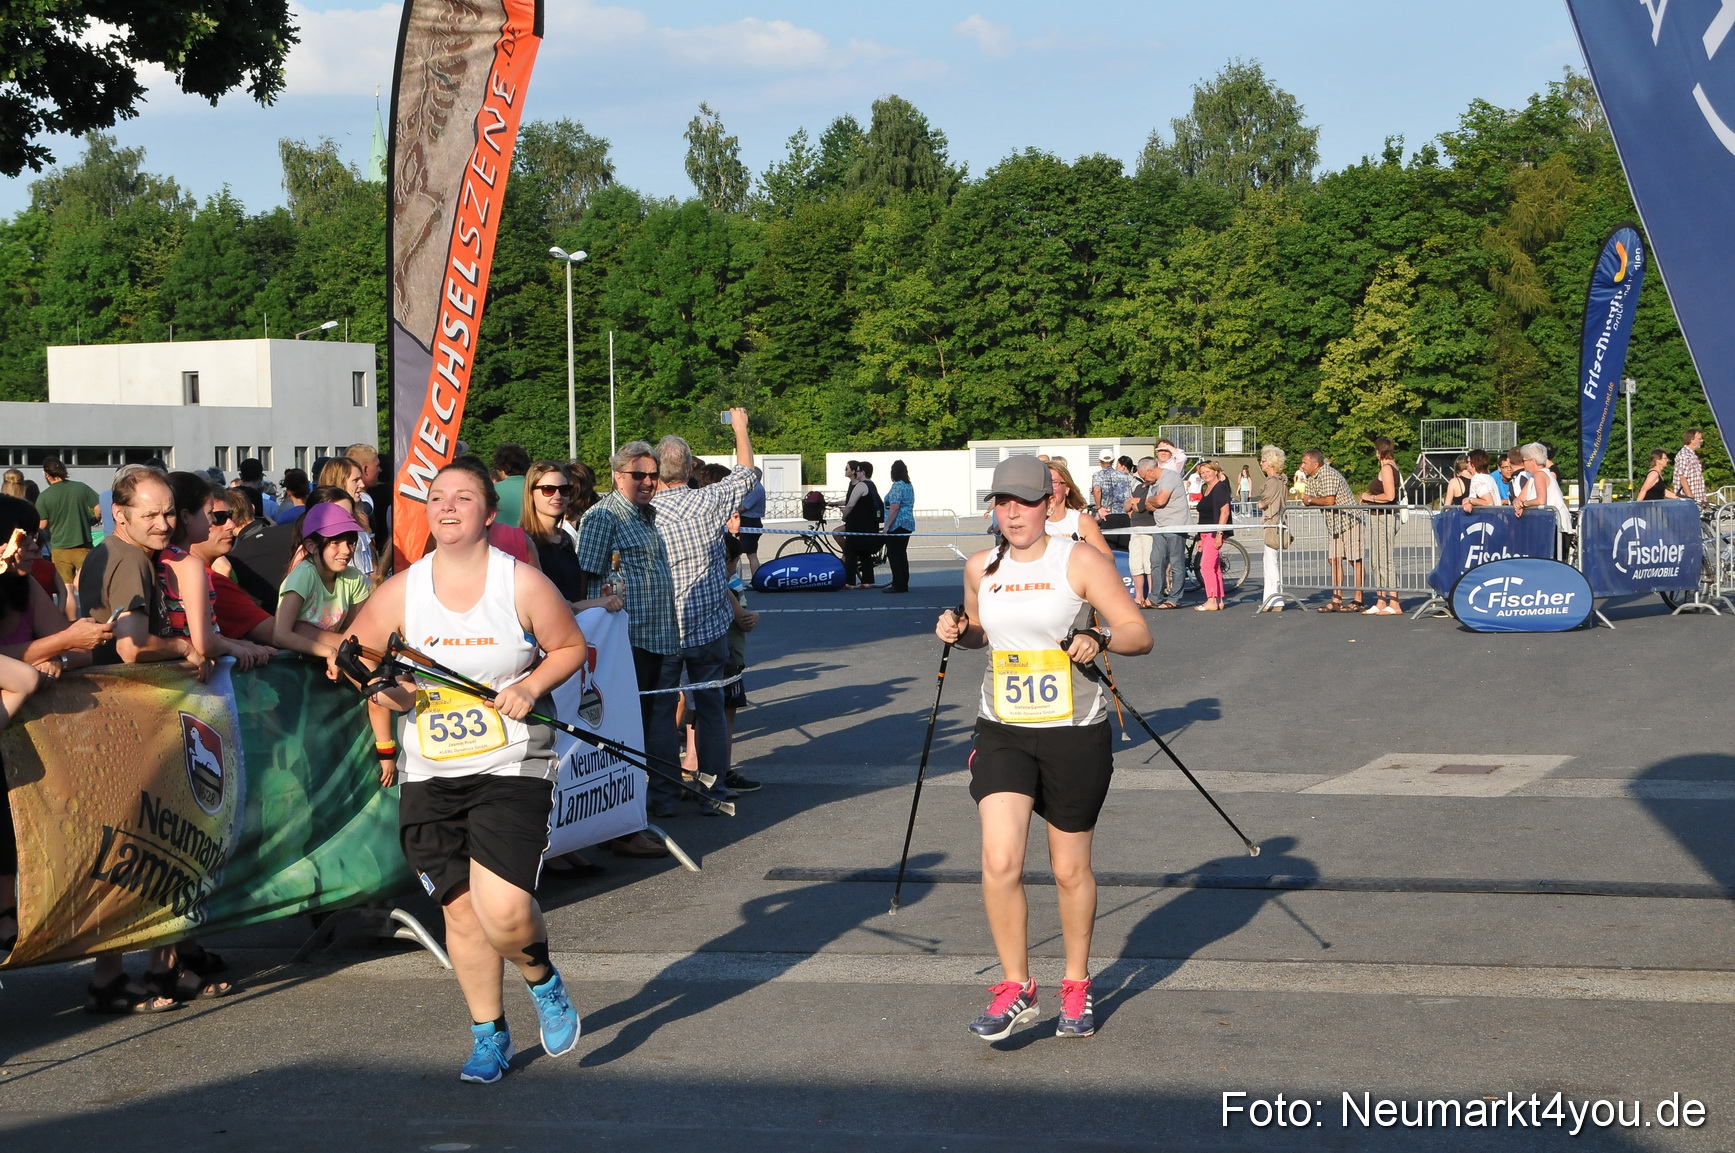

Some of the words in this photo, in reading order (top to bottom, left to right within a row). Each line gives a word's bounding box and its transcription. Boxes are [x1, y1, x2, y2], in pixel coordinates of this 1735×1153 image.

[1586, 381, 1615, 468] www.frischmann-net.de
[1464, 545, 1530, 569] Fisch
[1627, 539, 1685, 566] Fischer
[777, 570, 835, 587] Fischer
[1632, 566, 1680, 580] AUTOMOBILE
[785, 580, 832, 590] AUTOMOBILE
[1005, 583, 1056, 592] KLEBL
[1487, 589, 1576, 608] Fischer
[1496, 606, 1569, 617] AUTOMOBILE
[442, 637, 499, 646] KLEBL
[1005, 674, 1058, 704] 516
[429, 708, 487, 742] 533
[556, 768, 635, 829] Lammsbräu
